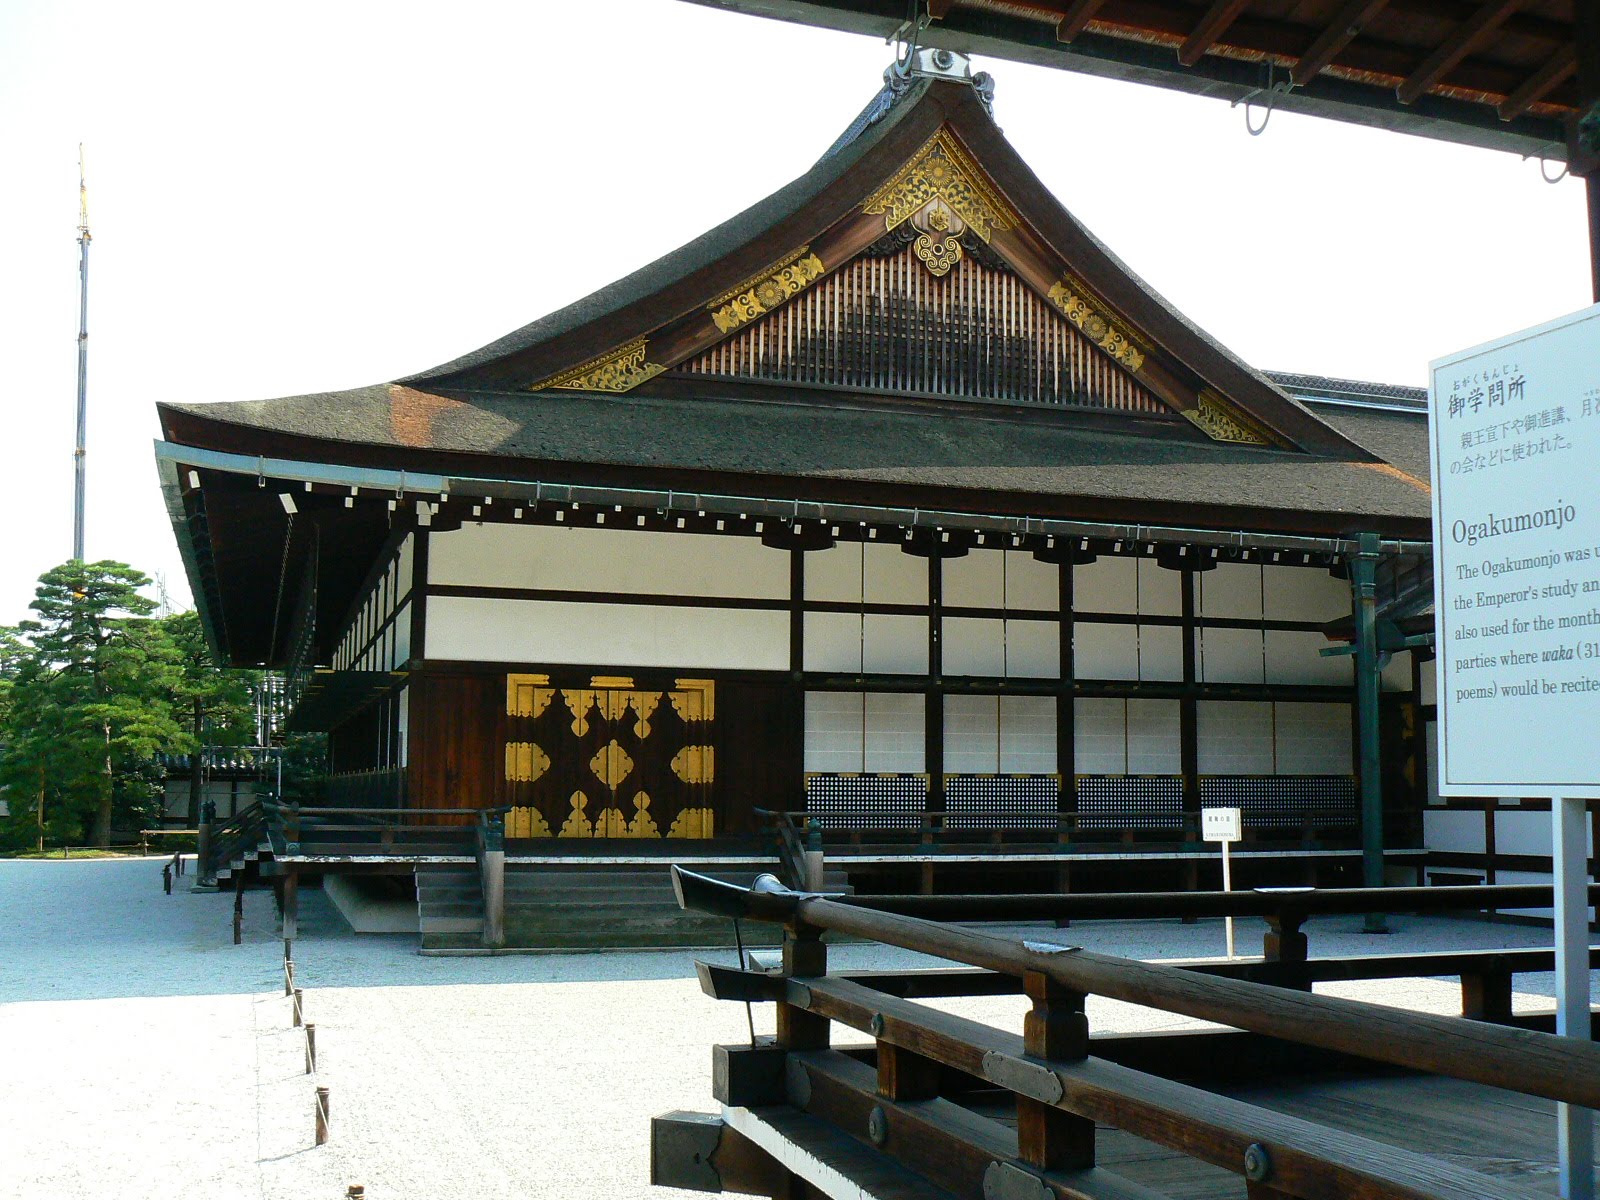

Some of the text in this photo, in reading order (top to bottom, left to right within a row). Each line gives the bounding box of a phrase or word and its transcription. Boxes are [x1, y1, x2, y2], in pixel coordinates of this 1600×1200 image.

[1453, 364, 1519, 391] おがくもんじょ
[1448, 374, 1526, 419] 御学問所
[1450, 433, 1573, 475] の会などに使われた。
[1452, 499, 1576, 546] Ogakumonjo
[1456, 564, 1479, 580] The
[1481, 549, 1560, 578] Ogakumonjo
[1564, 548, 1591, 563] was
[1454, 595, 1473, 610] the
[1476, 585, 1538, 608] Emperor's
[1541, 579, 1579, 598] study
[1455, 608, 1600, 640] also used for the month
[1455, 653, 1497, 673] parties
[1500, 650, 1538, 666] where
[1541, 645, 1574, 662] waka
[1456, 680, 1498, 703] poems)
[1500, 679, 1539, 697] would
[1542, 679, 1557, 694] be
